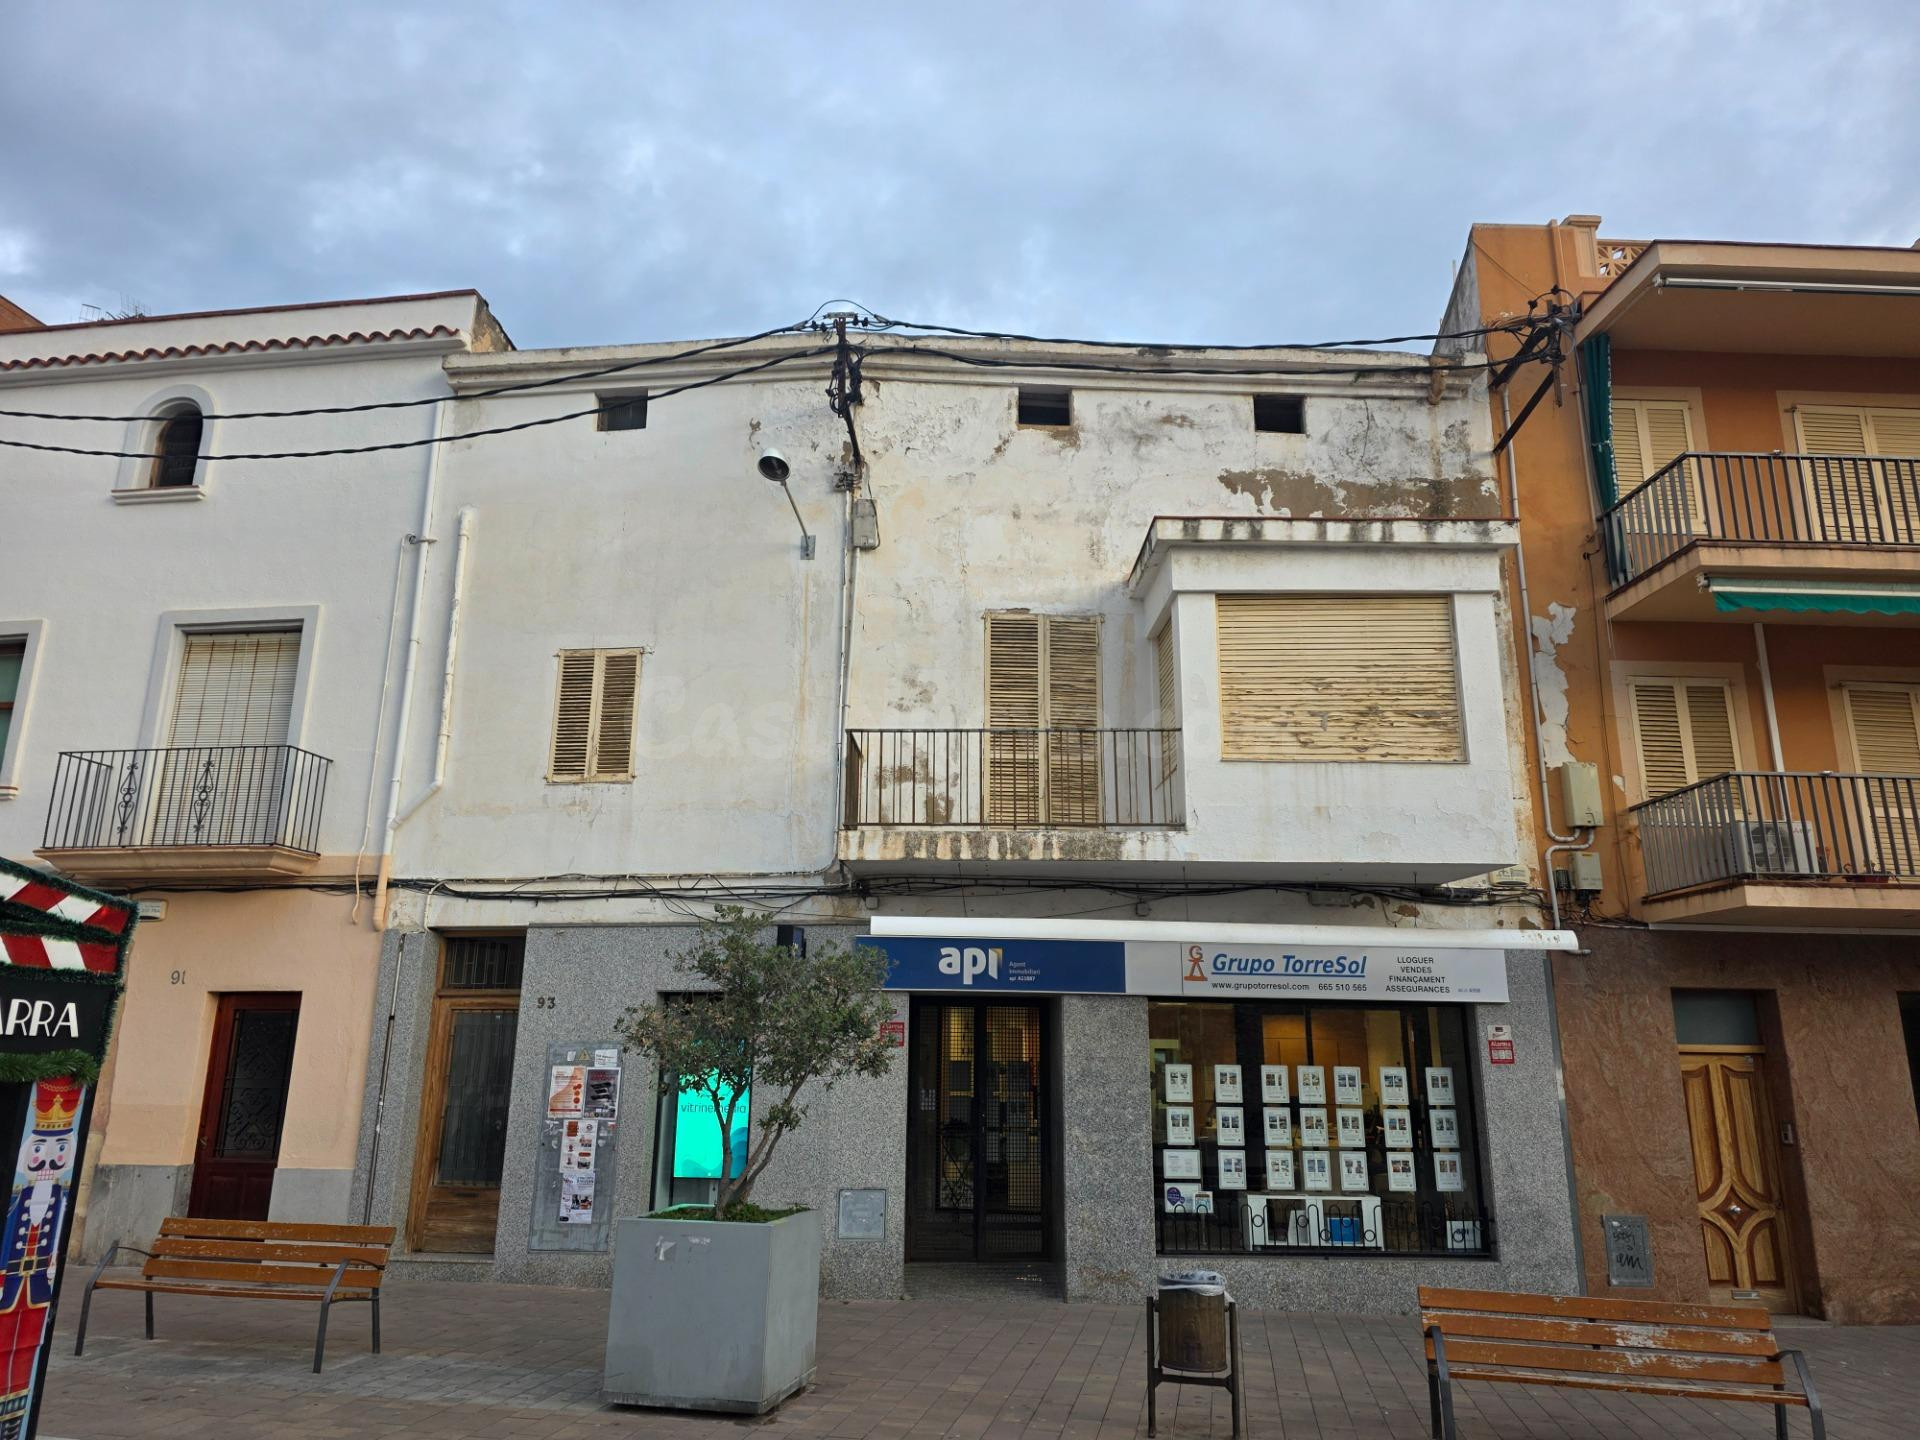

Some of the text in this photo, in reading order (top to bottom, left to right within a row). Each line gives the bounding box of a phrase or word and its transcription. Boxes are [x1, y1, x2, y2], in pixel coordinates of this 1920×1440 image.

[938, 946, 1003, 985] api
[1211, 953, 1367, 975] Grupo TorreSol
[1396, 956, 1435, 964] LLOGUER
[1400, 966, 1433, 974] VENDES
[170, 969, 186, 985] 91
[1388, 975, 1446, 984] FINANÇAMENT
[1211, 982, 1368, 992] www.grupotorresol.com 665 510 565
[1385, 985, 1451, 993] ASSEGURANCES
[537, 996, 556, 1010] 93
[0, 998, 79, 1038] RRA
[680, 1101, 748, 1113] vitrineeia
